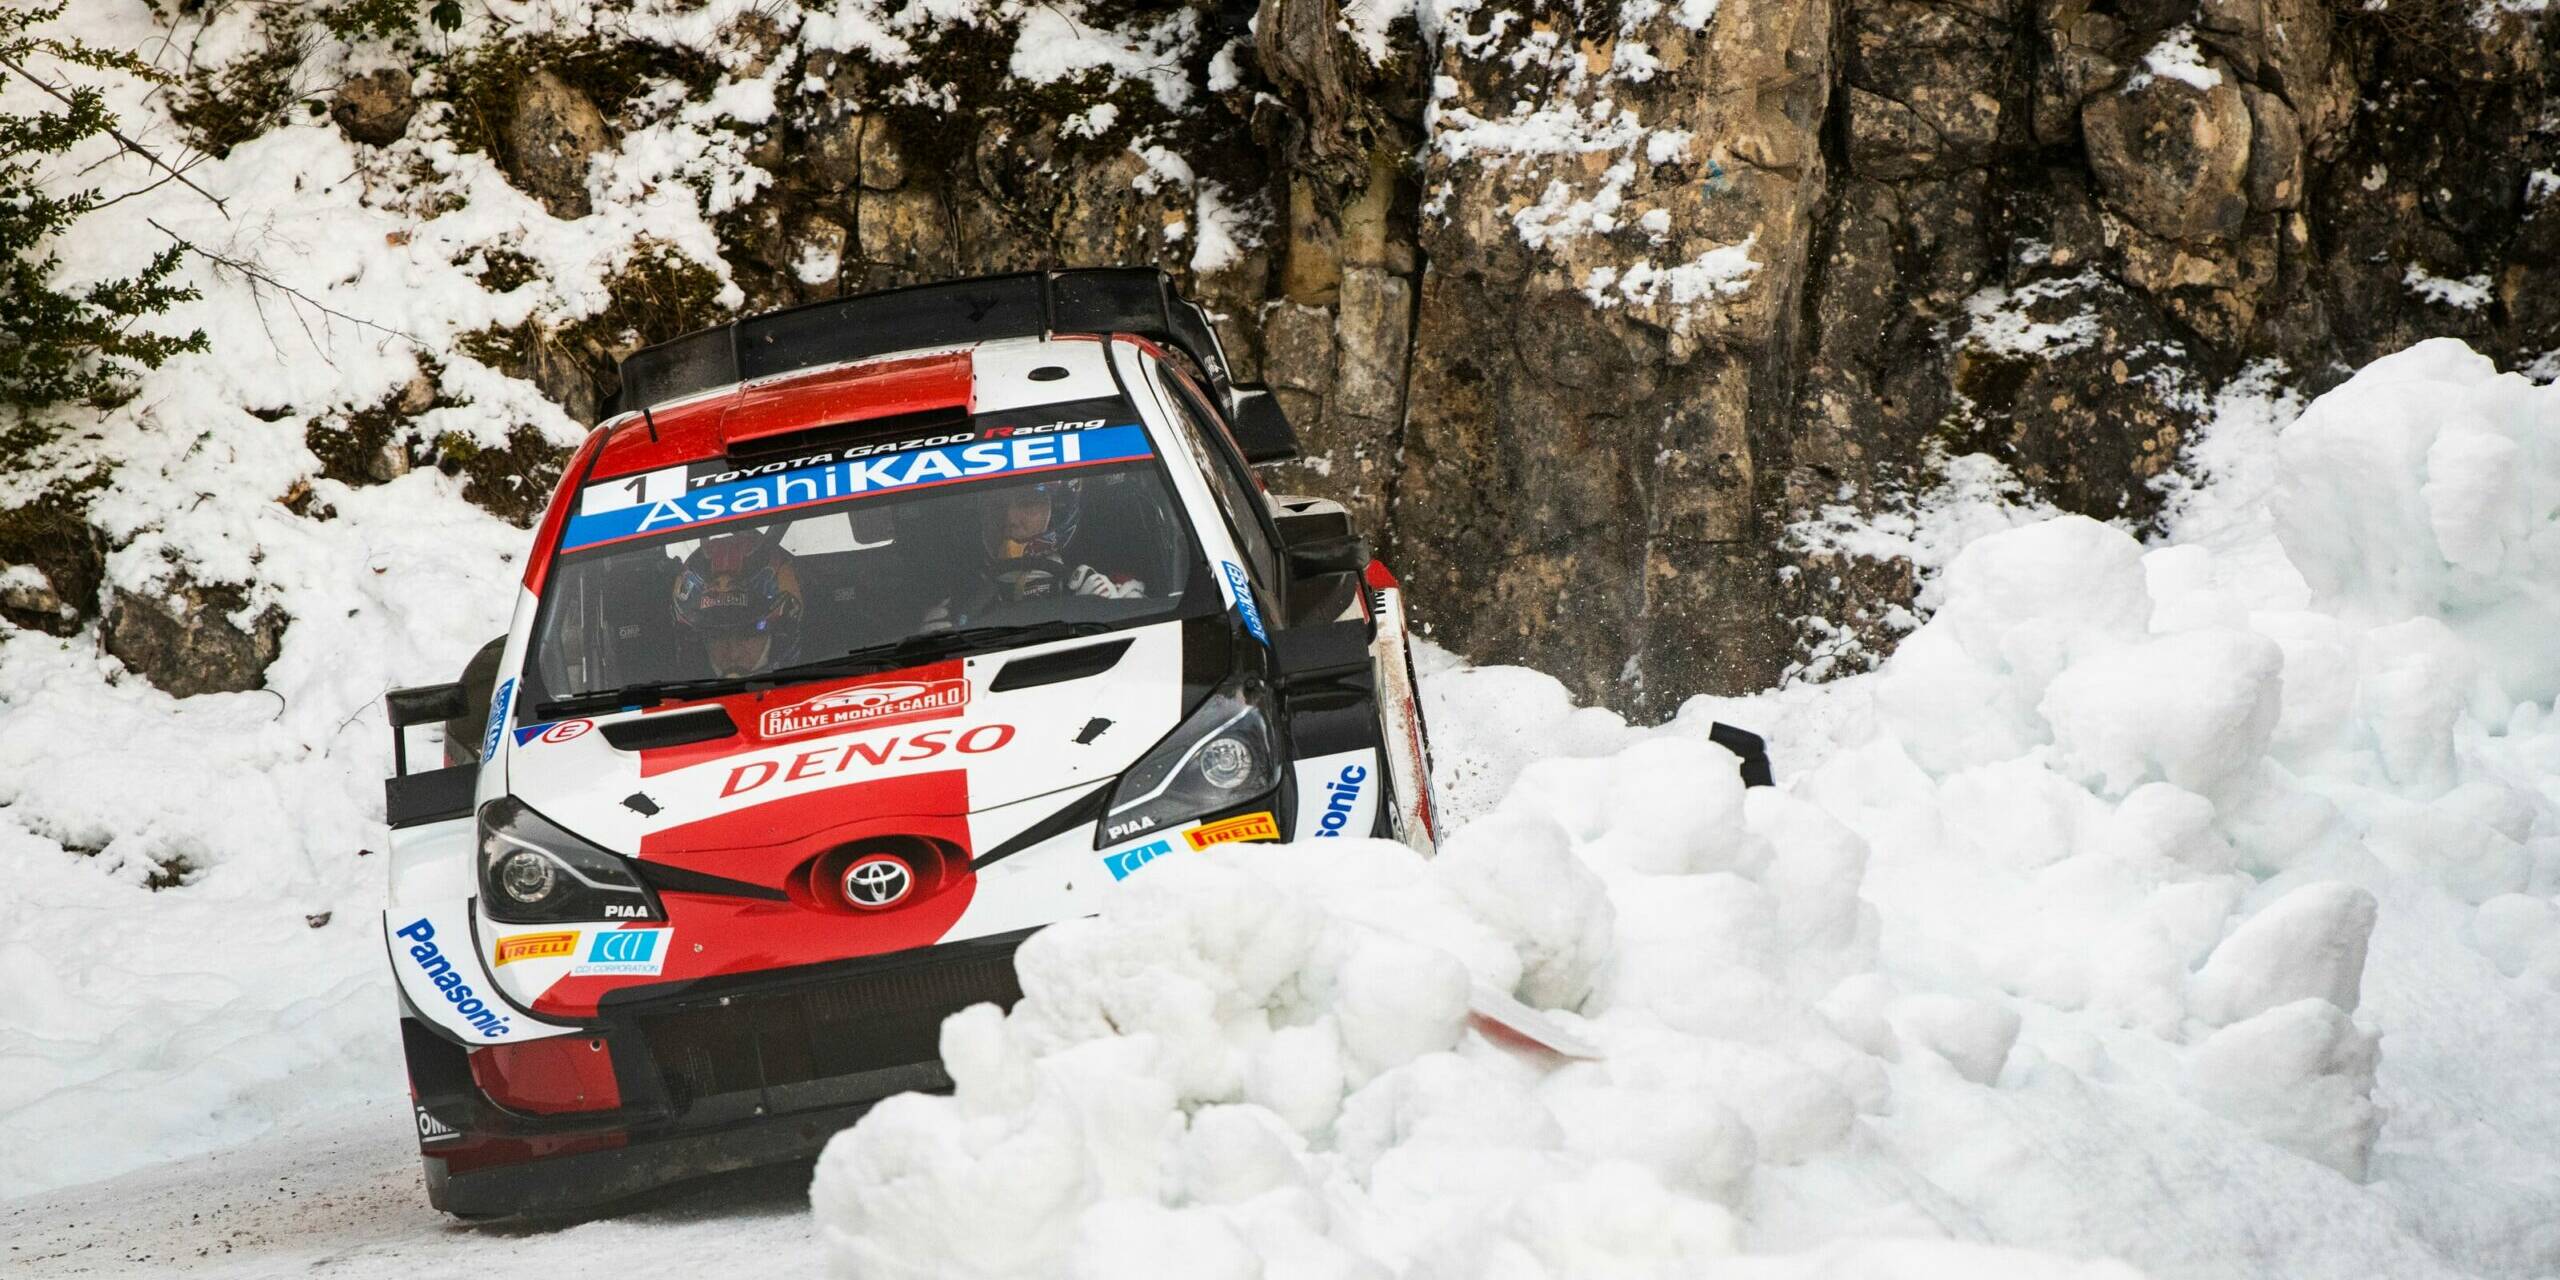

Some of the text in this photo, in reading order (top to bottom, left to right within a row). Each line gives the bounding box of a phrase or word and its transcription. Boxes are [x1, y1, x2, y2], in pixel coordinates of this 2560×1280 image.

[690, 418, 1106, 487] TOYOTA GAZOO Racing
[624, 475, 647, 504] 1
[769, 687, 960, 735] RALLYE MONTE-CARLO
[555, 724, 581, 739] E
[719, 724, 1016, 798] DENSO
[1108, 816, 1156, 840] PIAA
[1191, 816, 1274, 847] PIRELLI
[604, 905, 649, 918] PIAA
[498, 934, 573, 961] PIRELLI
[602, 932, 644, 961] CCI
[395, 917, 511, 1038] Panasonic
[593, 964, 659, 974] CORPORATION
